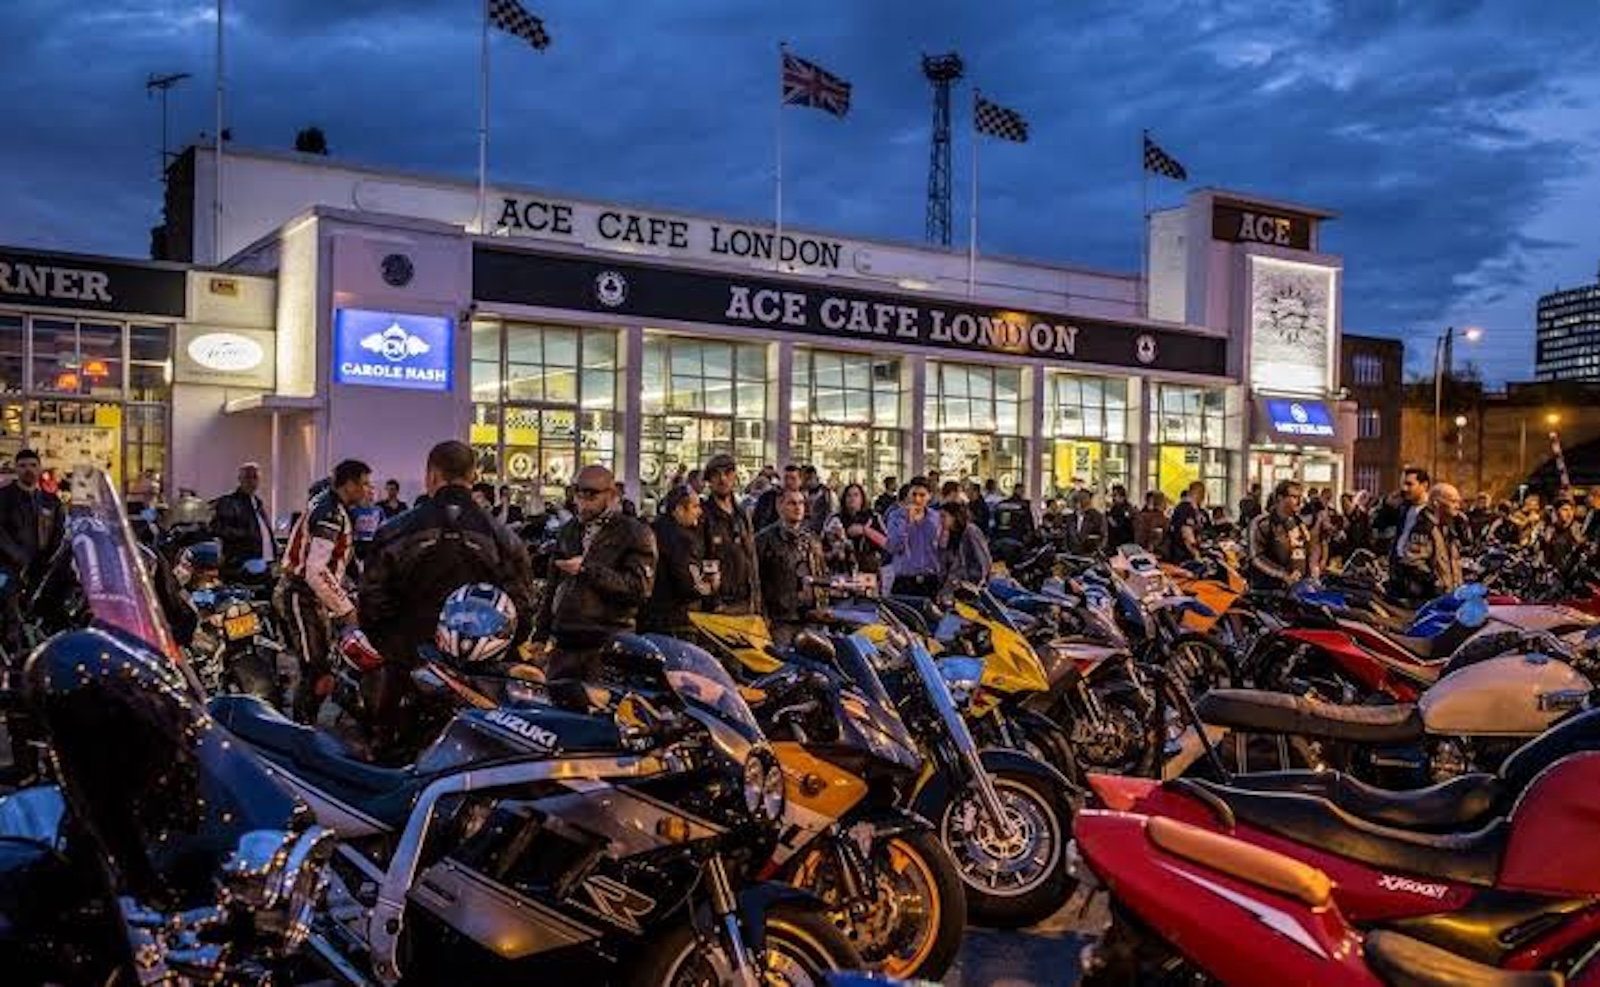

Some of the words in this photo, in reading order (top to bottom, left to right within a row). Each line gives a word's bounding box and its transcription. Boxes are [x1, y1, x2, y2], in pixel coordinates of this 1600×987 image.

[498, 199, 574, 234] ACE
[597, 211, 689, 248] CAFE
[710, 226, 842, 269] LONDON
[1238, 211, 1291, 246] ACE
[725, 286, 808, 325] ACE
[819, 298, 919, 338] CAFE
[929, 310, 1080, 355] LONDON
[341, 362, 402, 378] CAROLE
[405, 366, 447, 382] NASH
[484, 710, 558, 747] SUZUKI
